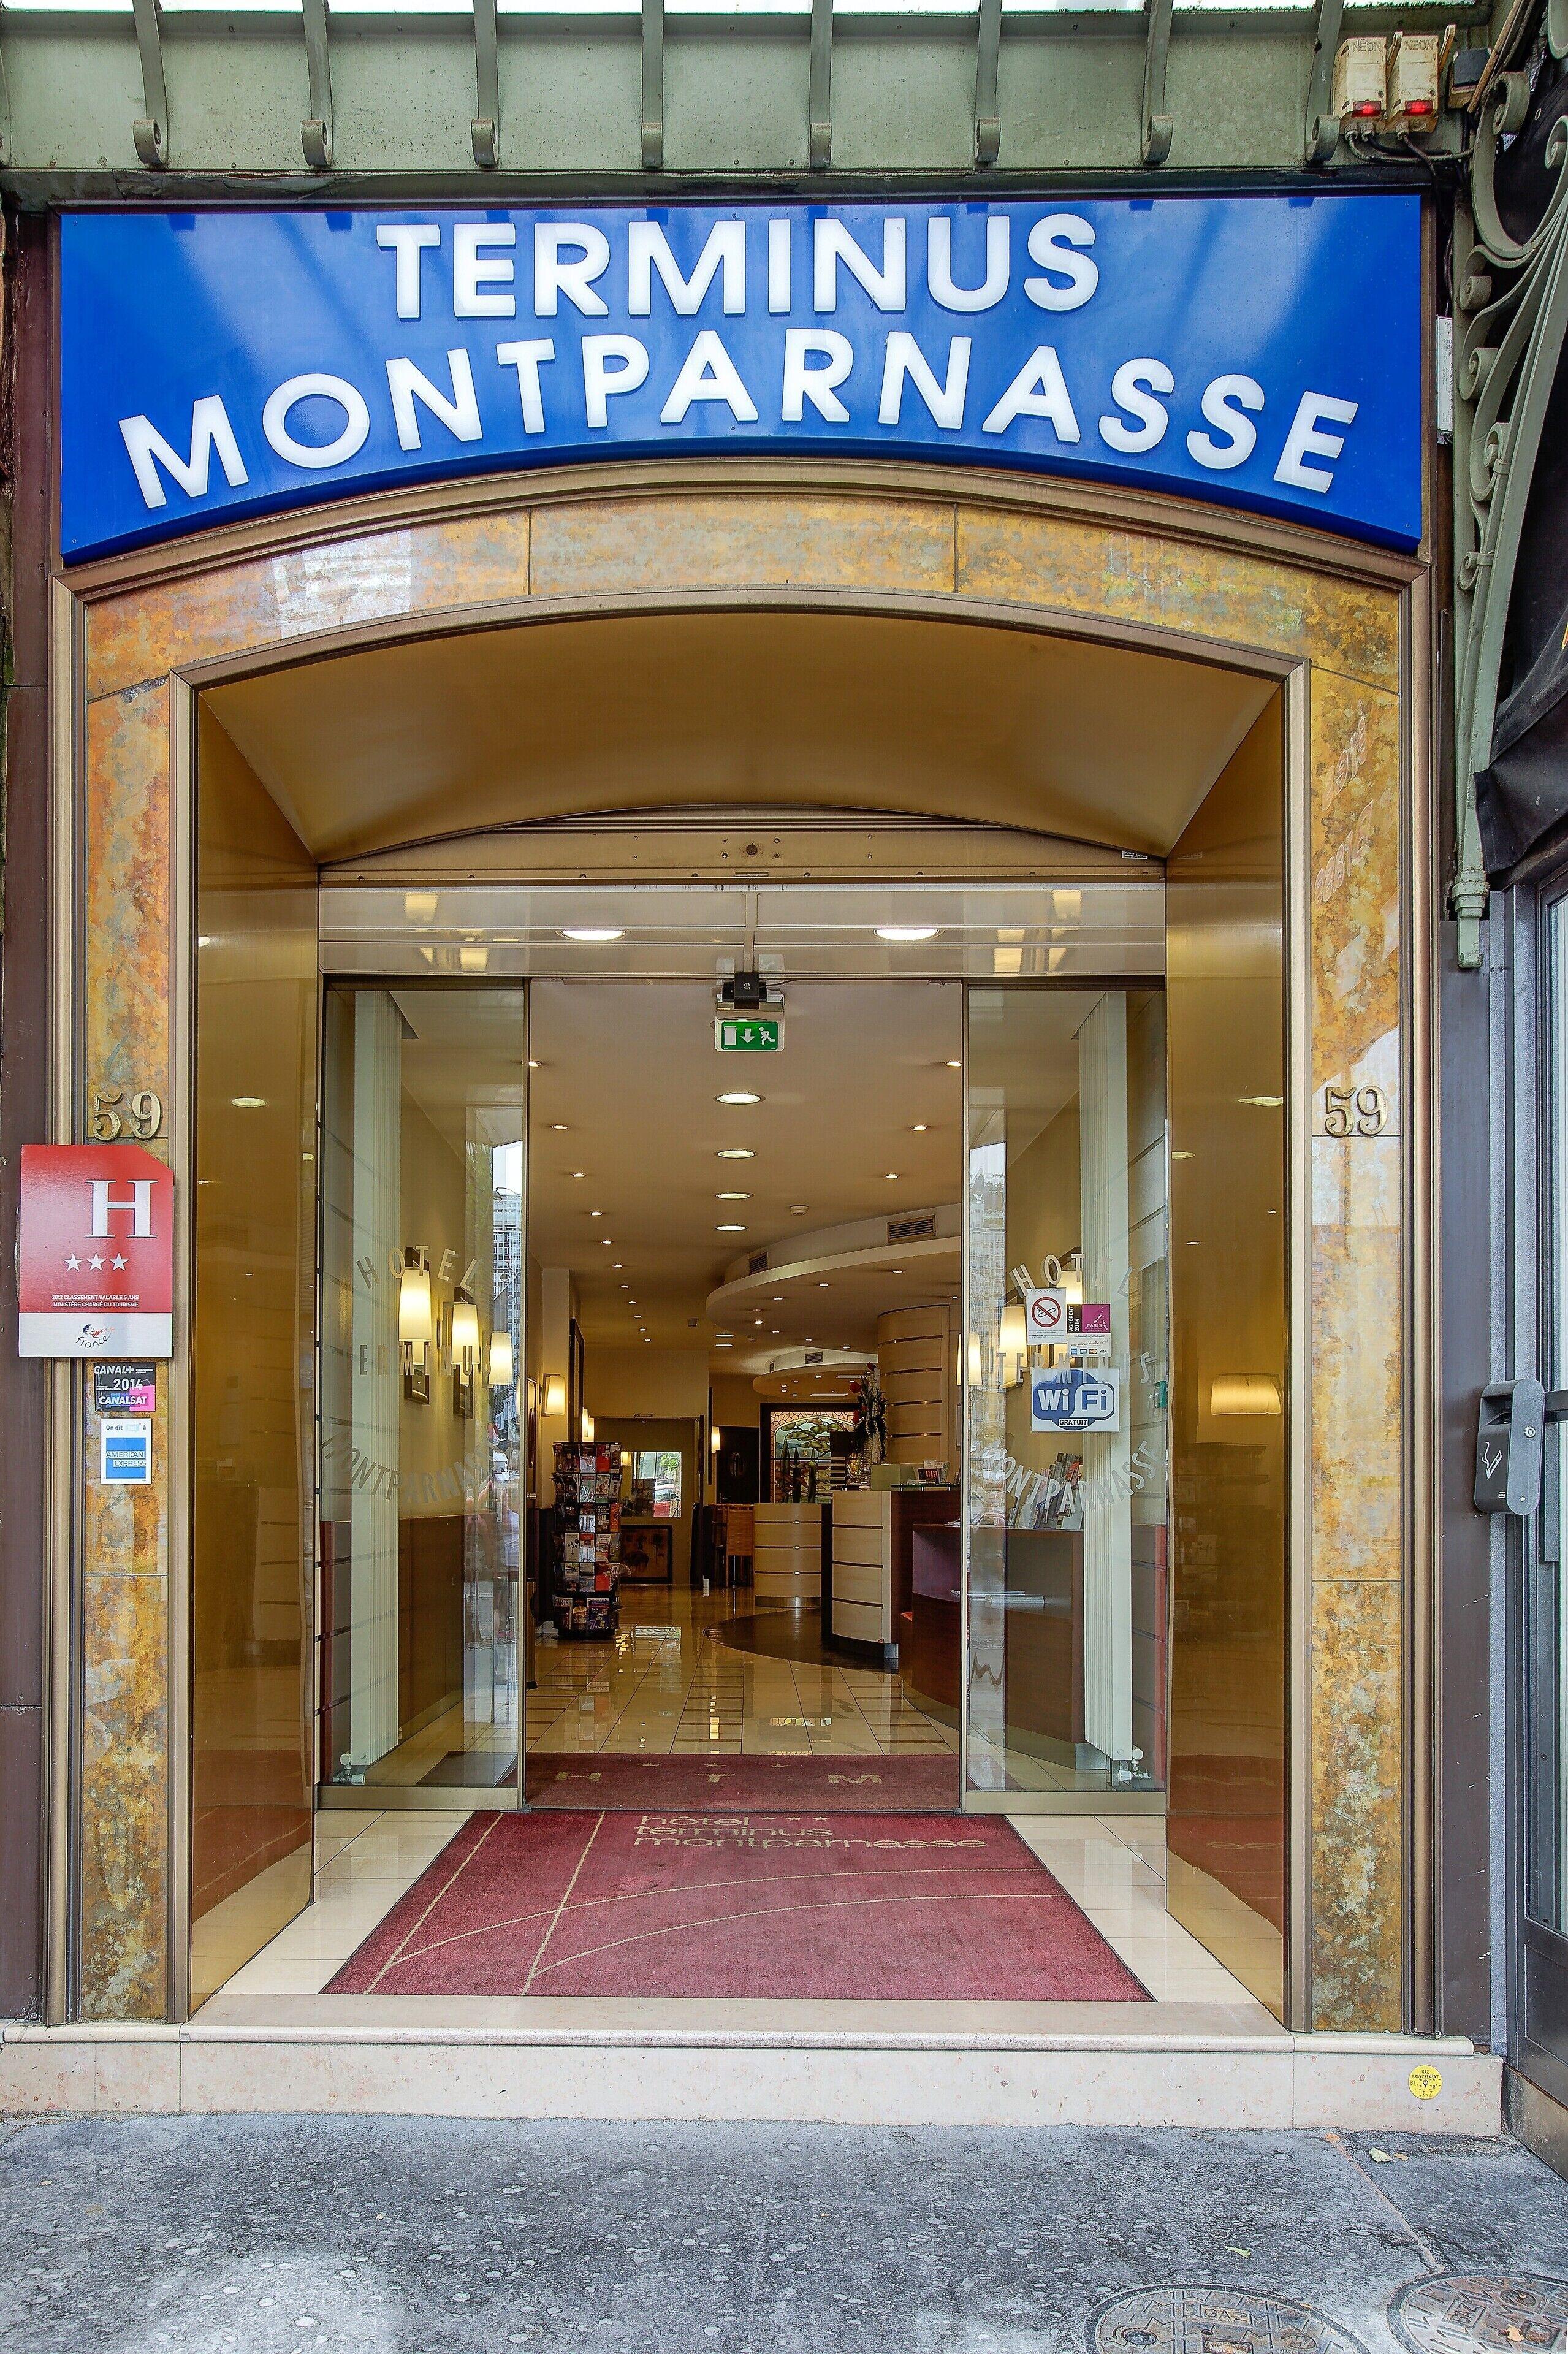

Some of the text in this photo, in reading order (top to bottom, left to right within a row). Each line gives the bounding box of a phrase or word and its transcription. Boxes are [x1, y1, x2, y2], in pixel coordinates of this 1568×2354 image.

[1352, 40, 1382, 52] NEON
[1404, 40, 1433, 51] NEON
[376, 213, 1098, 318] TERMINUS
[118, 327, 1360, 509] MONTPARNASSE
[91, 1090, 164, 1141] 59
[1324, 1085, 1388, 1137] 59
[85, 1179, 158, 1238] H
[356, 1245, 478, 1293] HOTEL
[75, 1333, 111, 1348] france
[94, 1365, 134, 1374] CANAL+
[113, 1378, 143, 1391] 2014
[99, 1396, 147, 1405] CANALSAT
[641, 1815, 749, 1826] hôtel
[637, 1826, 833, 1837] terminus
[634, 1837, 988, 1849] montparnasse
[1205, 2309, 1249, 2323] GAZ
